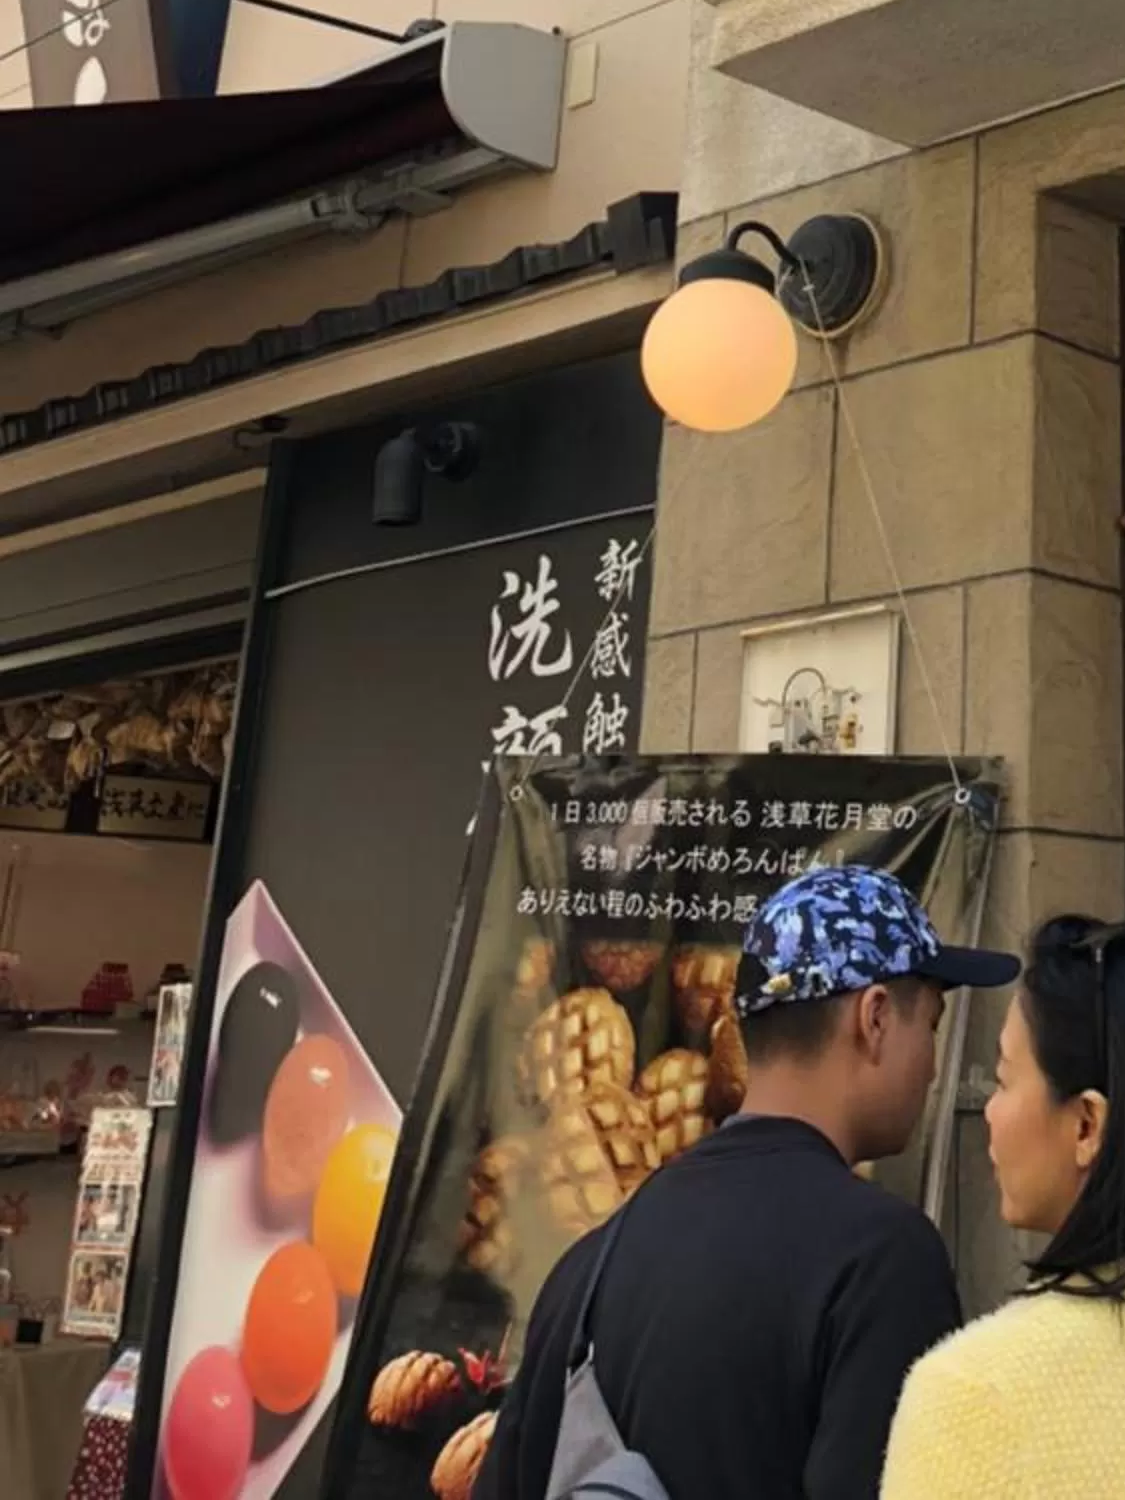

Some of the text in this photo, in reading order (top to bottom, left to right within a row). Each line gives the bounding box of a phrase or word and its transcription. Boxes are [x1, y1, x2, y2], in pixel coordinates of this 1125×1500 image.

[582, 538, 643, 756] 新感触
[761, 802, 917, 832] 浅草花月堂の
